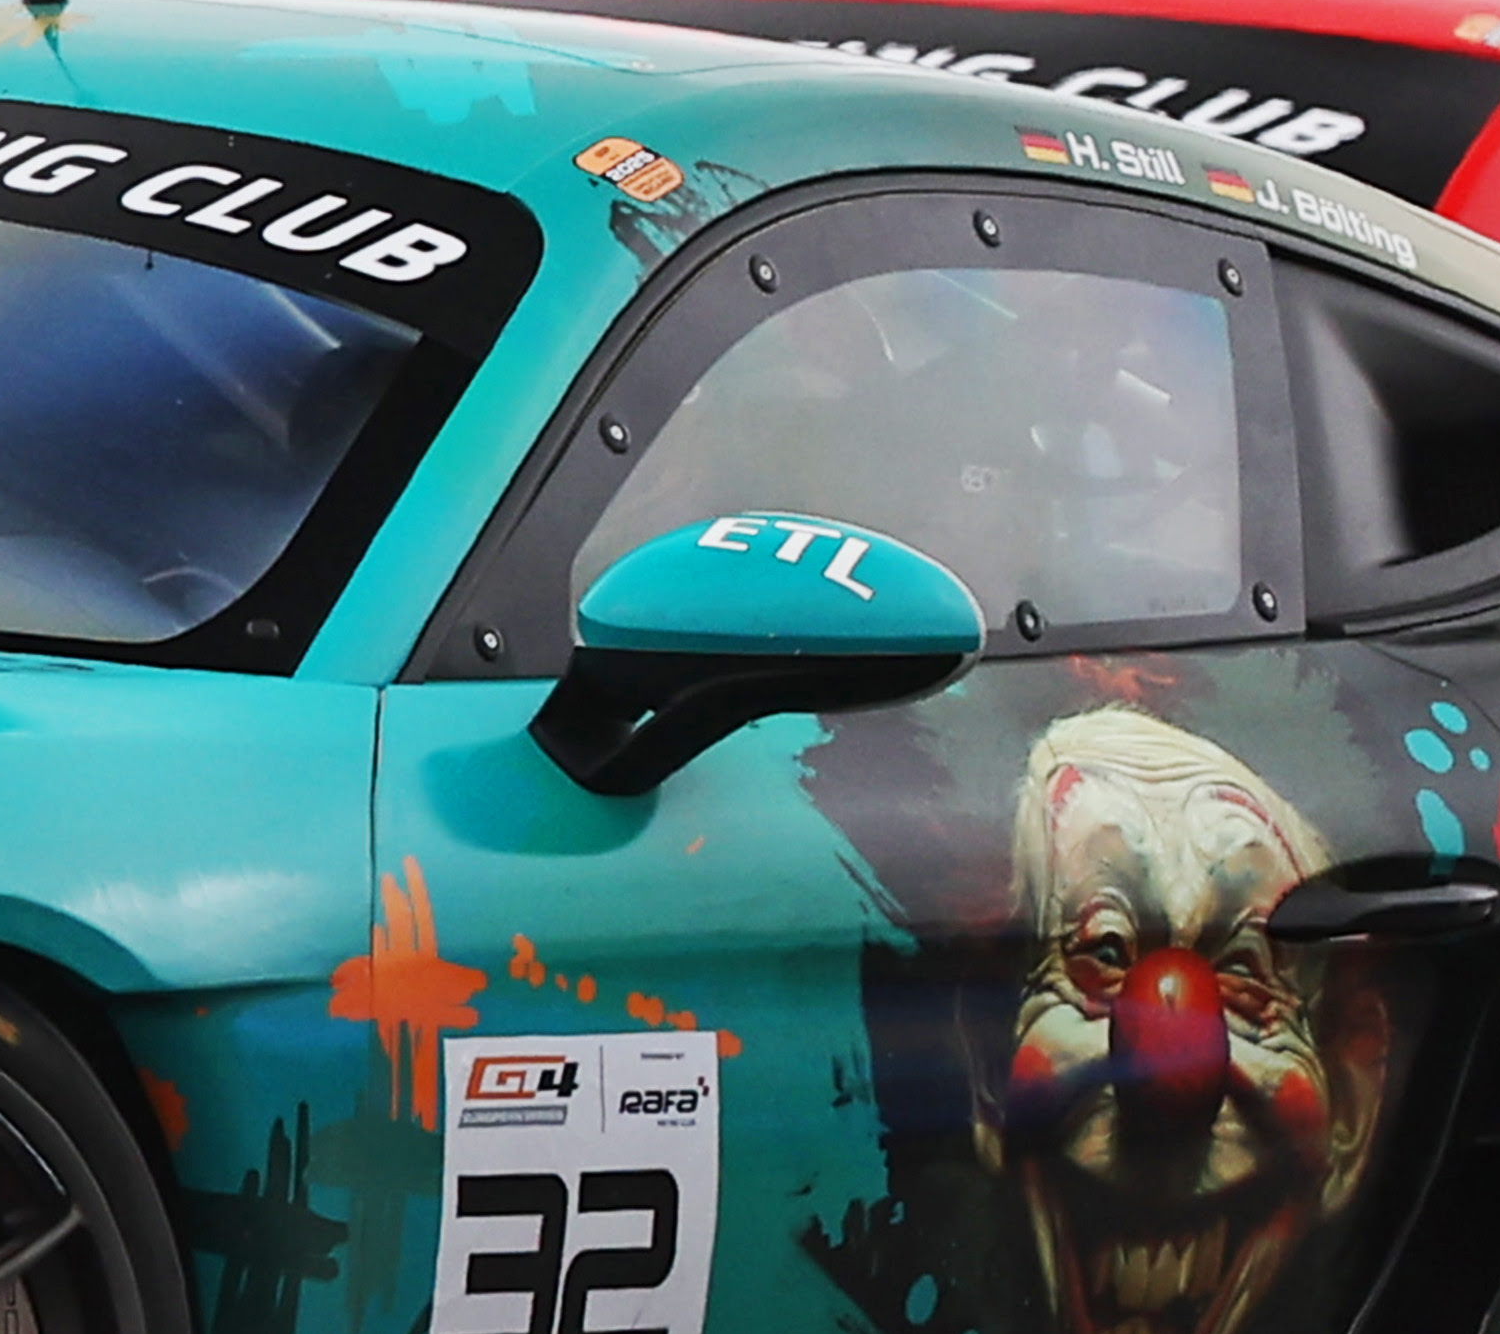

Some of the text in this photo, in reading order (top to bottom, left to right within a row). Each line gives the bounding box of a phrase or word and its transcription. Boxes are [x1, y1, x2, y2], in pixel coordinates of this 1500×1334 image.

[1050, 67, 1366, 156] CLUB
[1111, 140, 1186, 185] Still
[120, 164, 469, 283] CLUB
[1294, 189, 1417, 270] Bölting
[698, 516, 876, 601] ETL
